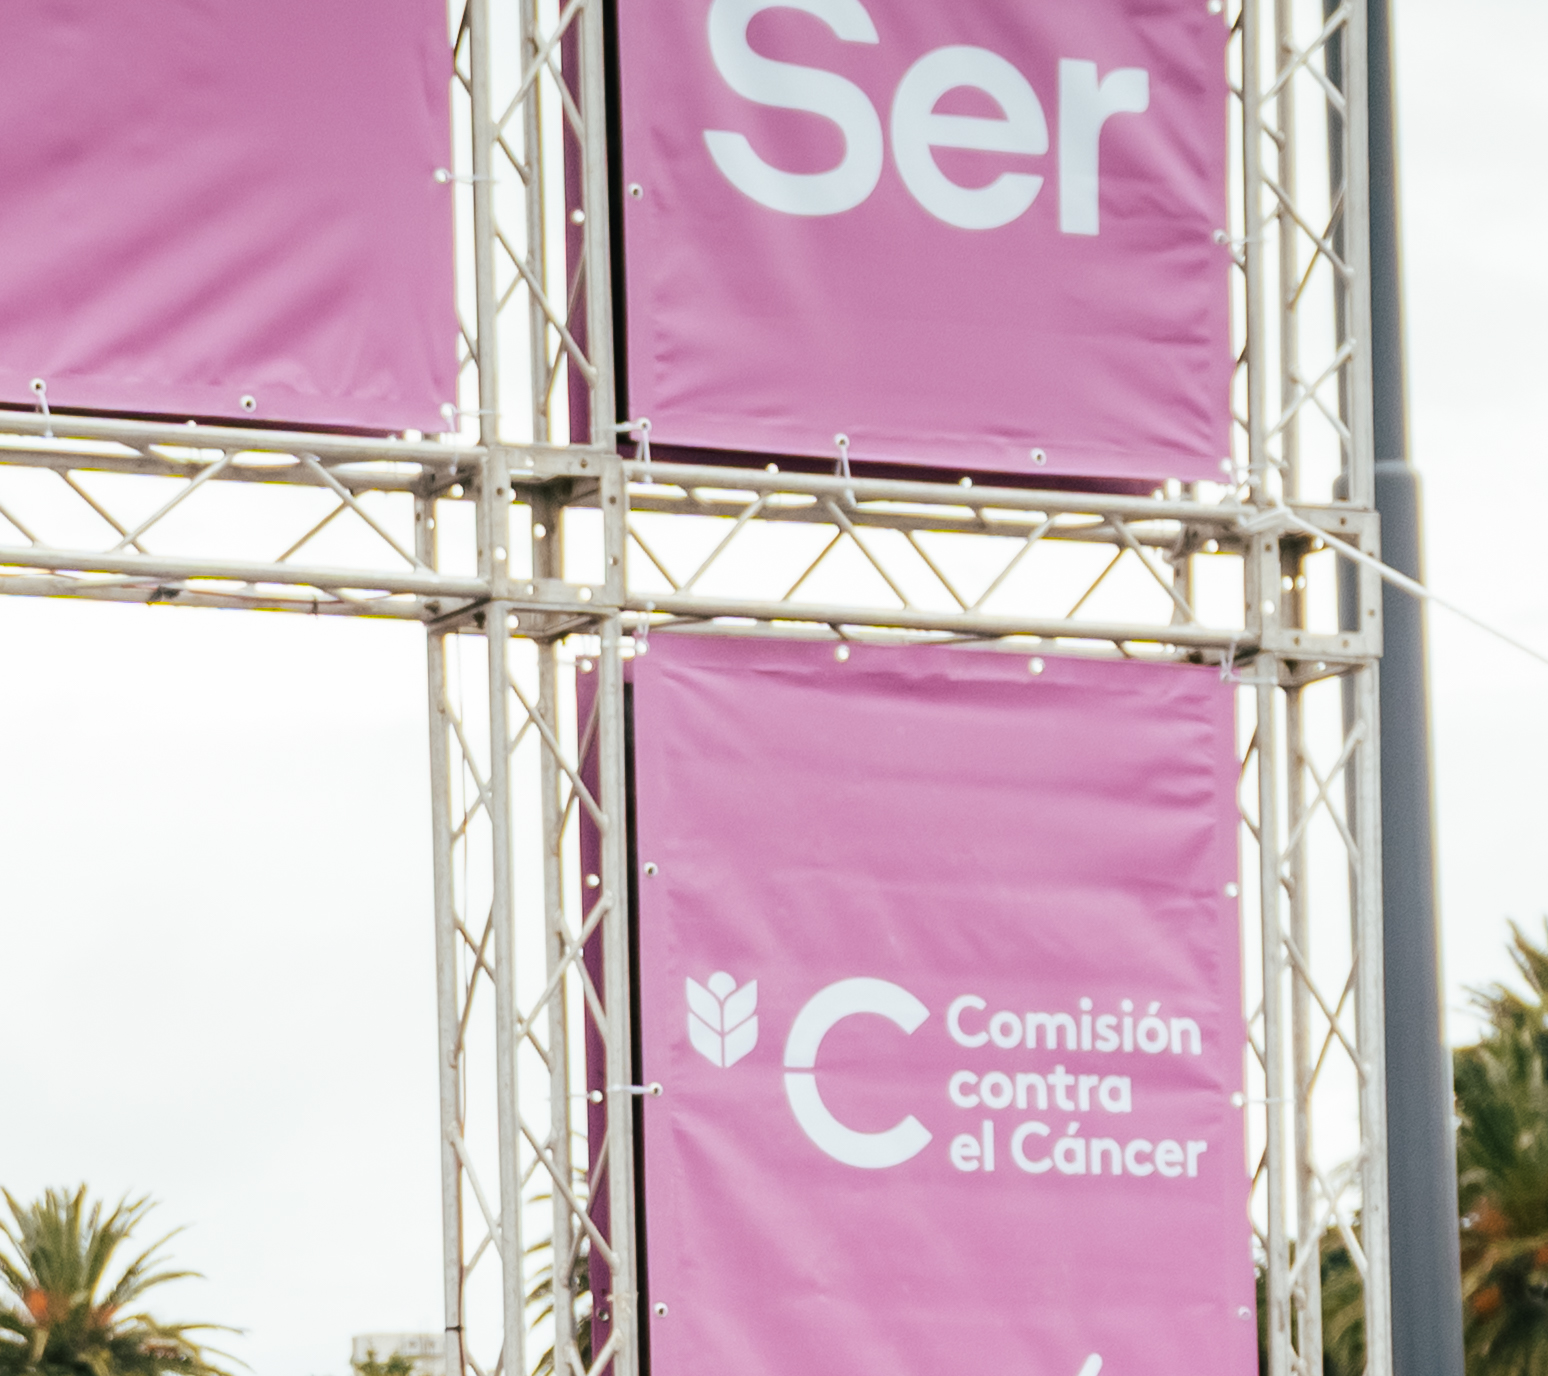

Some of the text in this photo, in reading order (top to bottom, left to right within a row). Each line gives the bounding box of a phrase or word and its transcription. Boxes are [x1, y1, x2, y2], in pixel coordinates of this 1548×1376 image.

[704, 0, 1149, 235] Ser
[947, 994, 1202, 1055] Comisión
[948, 1065, 1132, 1113] contra
[949, 1120, 1207, 1177] el Cáncer
